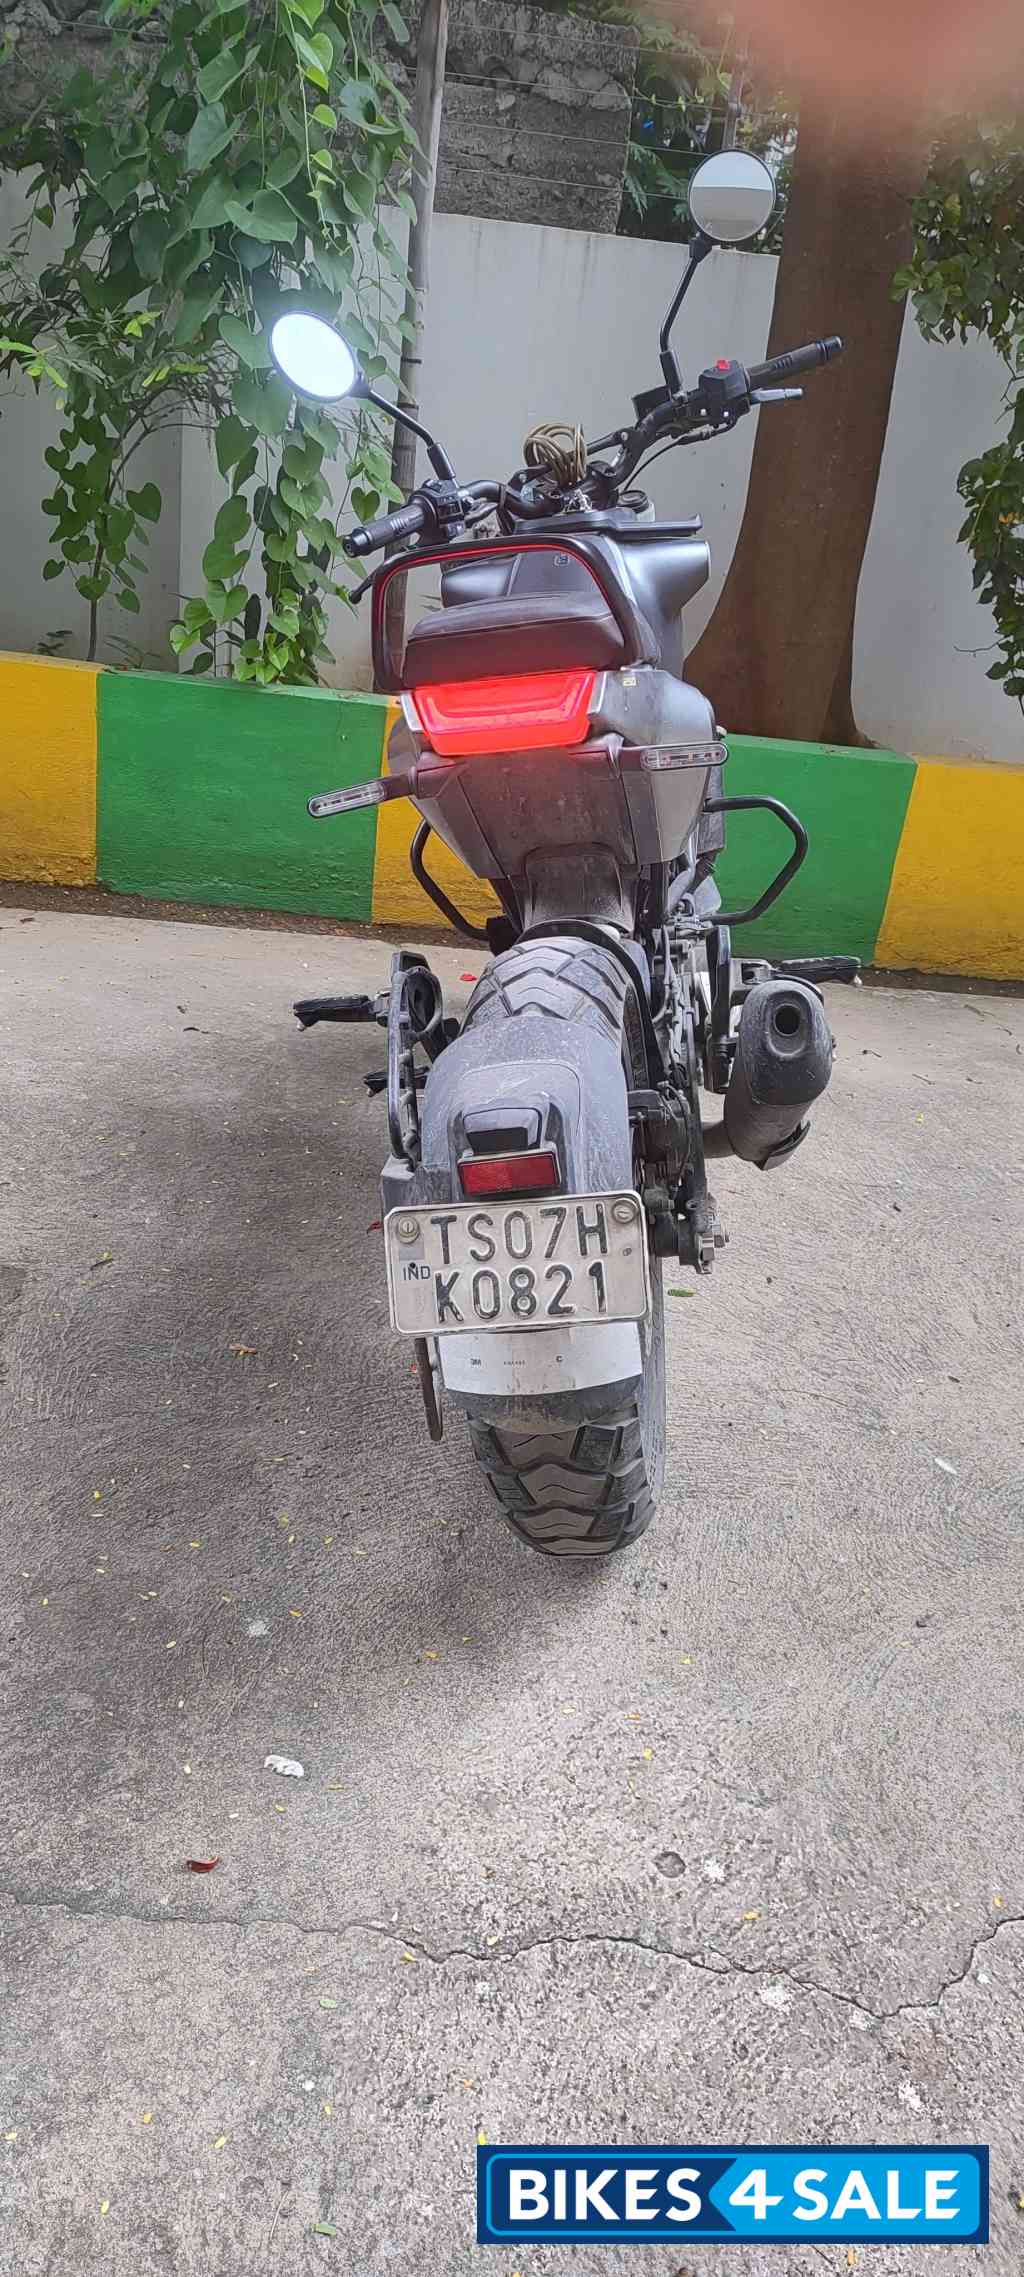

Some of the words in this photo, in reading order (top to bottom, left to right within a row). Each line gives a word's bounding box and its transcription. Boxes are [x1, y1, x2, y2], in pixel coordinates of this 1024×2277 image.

[431, 1203, 607, 1264] TS07H
[403, 1265, 431, 1281] IND
[434, 1262, 607, 1323] K0821
